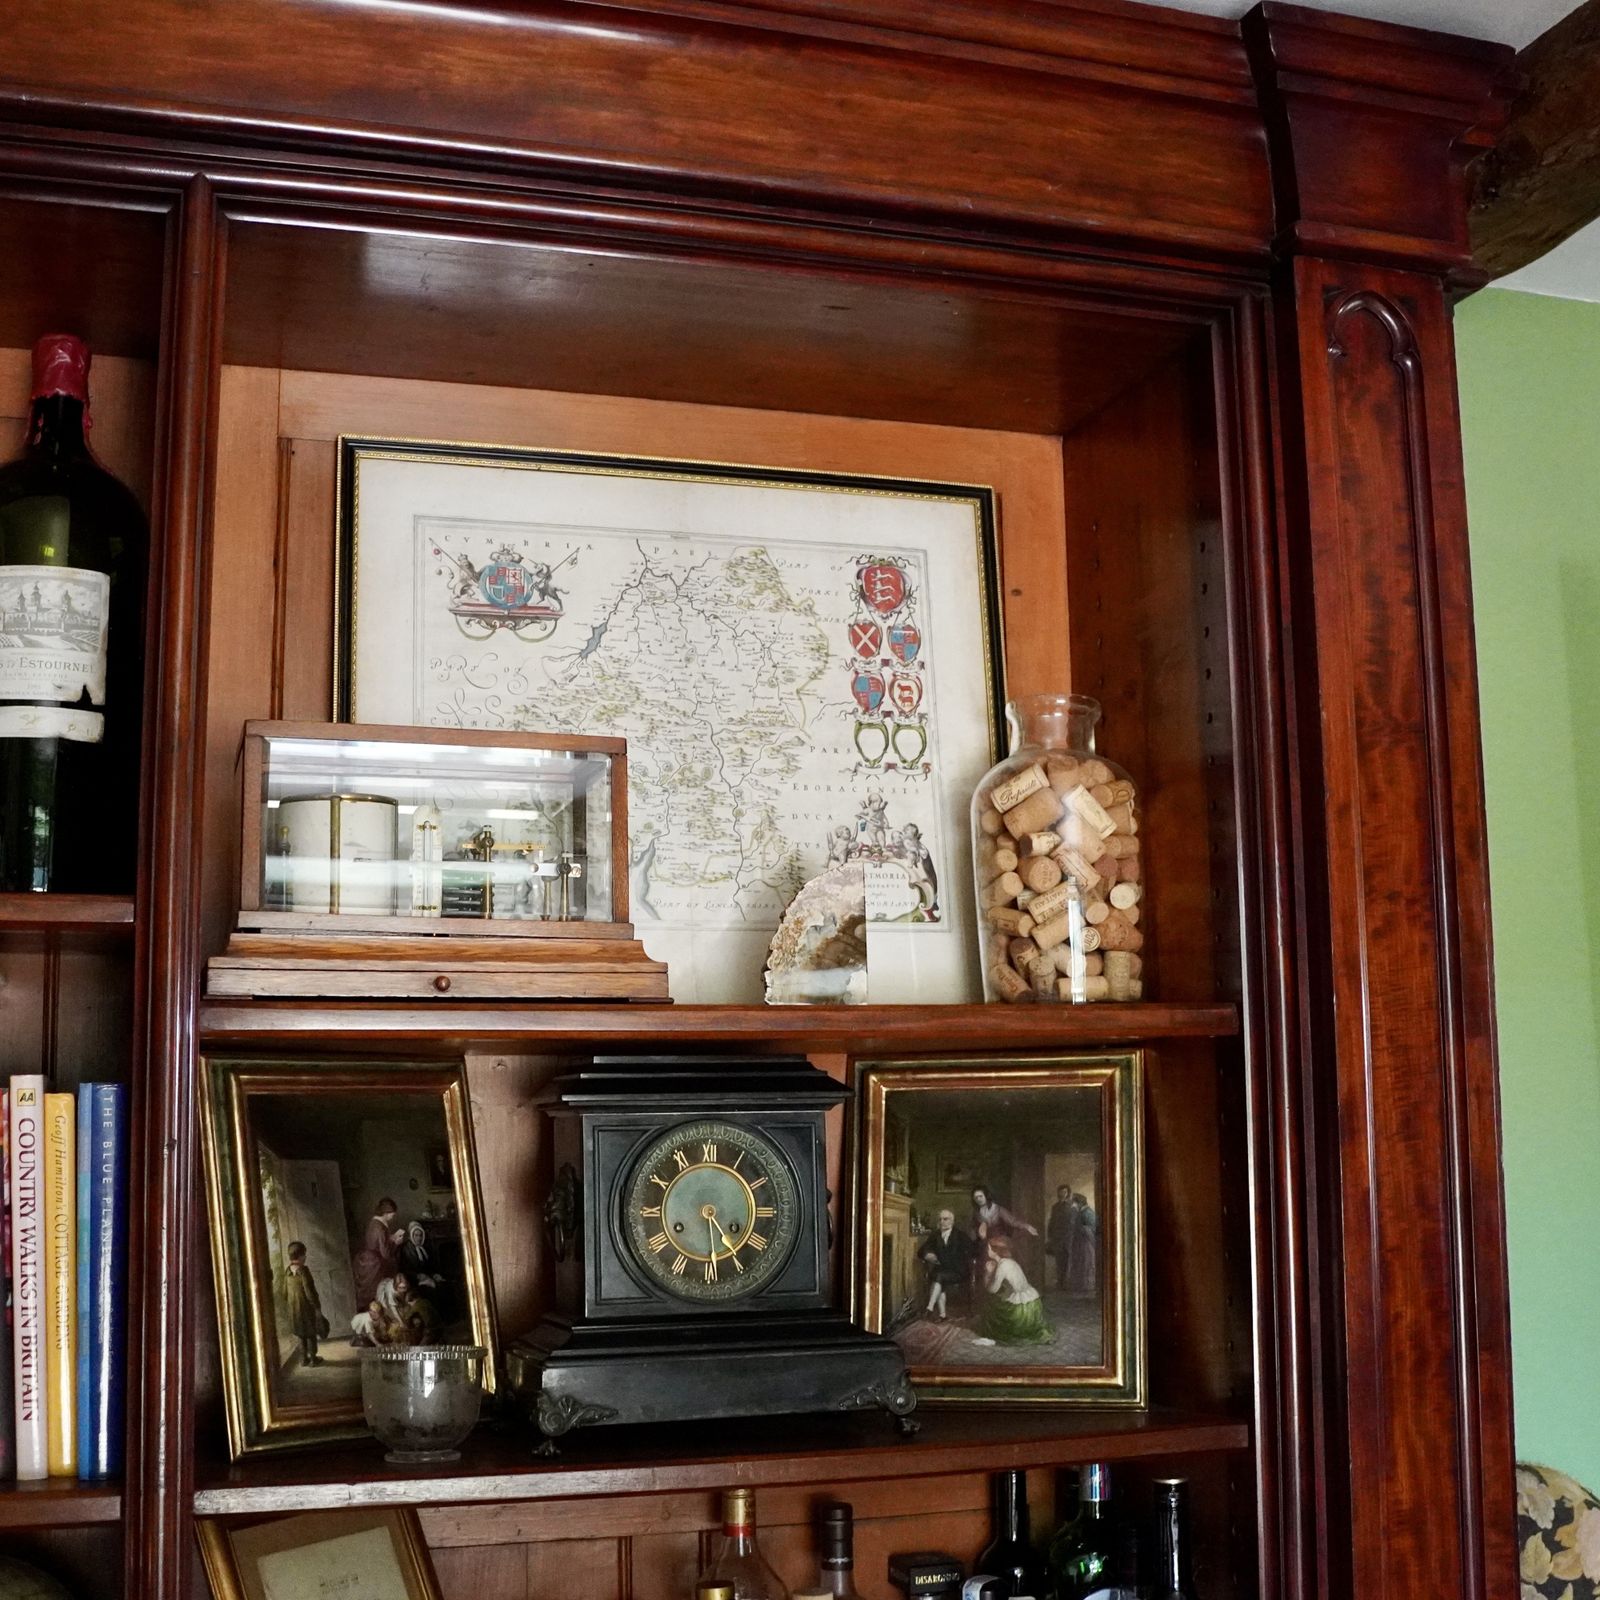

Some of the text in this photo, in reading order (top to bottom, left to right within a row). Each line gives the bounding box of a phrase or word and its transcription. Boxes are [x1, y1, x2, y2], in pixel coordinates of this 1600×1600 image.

[445, 535, 592, 550] CVMBRIA
[810, 745, 851, 754] PARS
[792, 813, 833, 821] DVCA
[20, 1092, 34, 1102] AA
[103, 1096, 113, 1128] THE
[702, 1144, 717, 1162] XII
[102, 1141, 113, 1184] BLUE
[650, 1174, 670, 1190] X
[51, 1115, 70, 1350] Geoff Hamilton's COTTAGE GARDENS
[18, 1117, 39, 1422] COUNTRY WALKS IN BRITAIN
